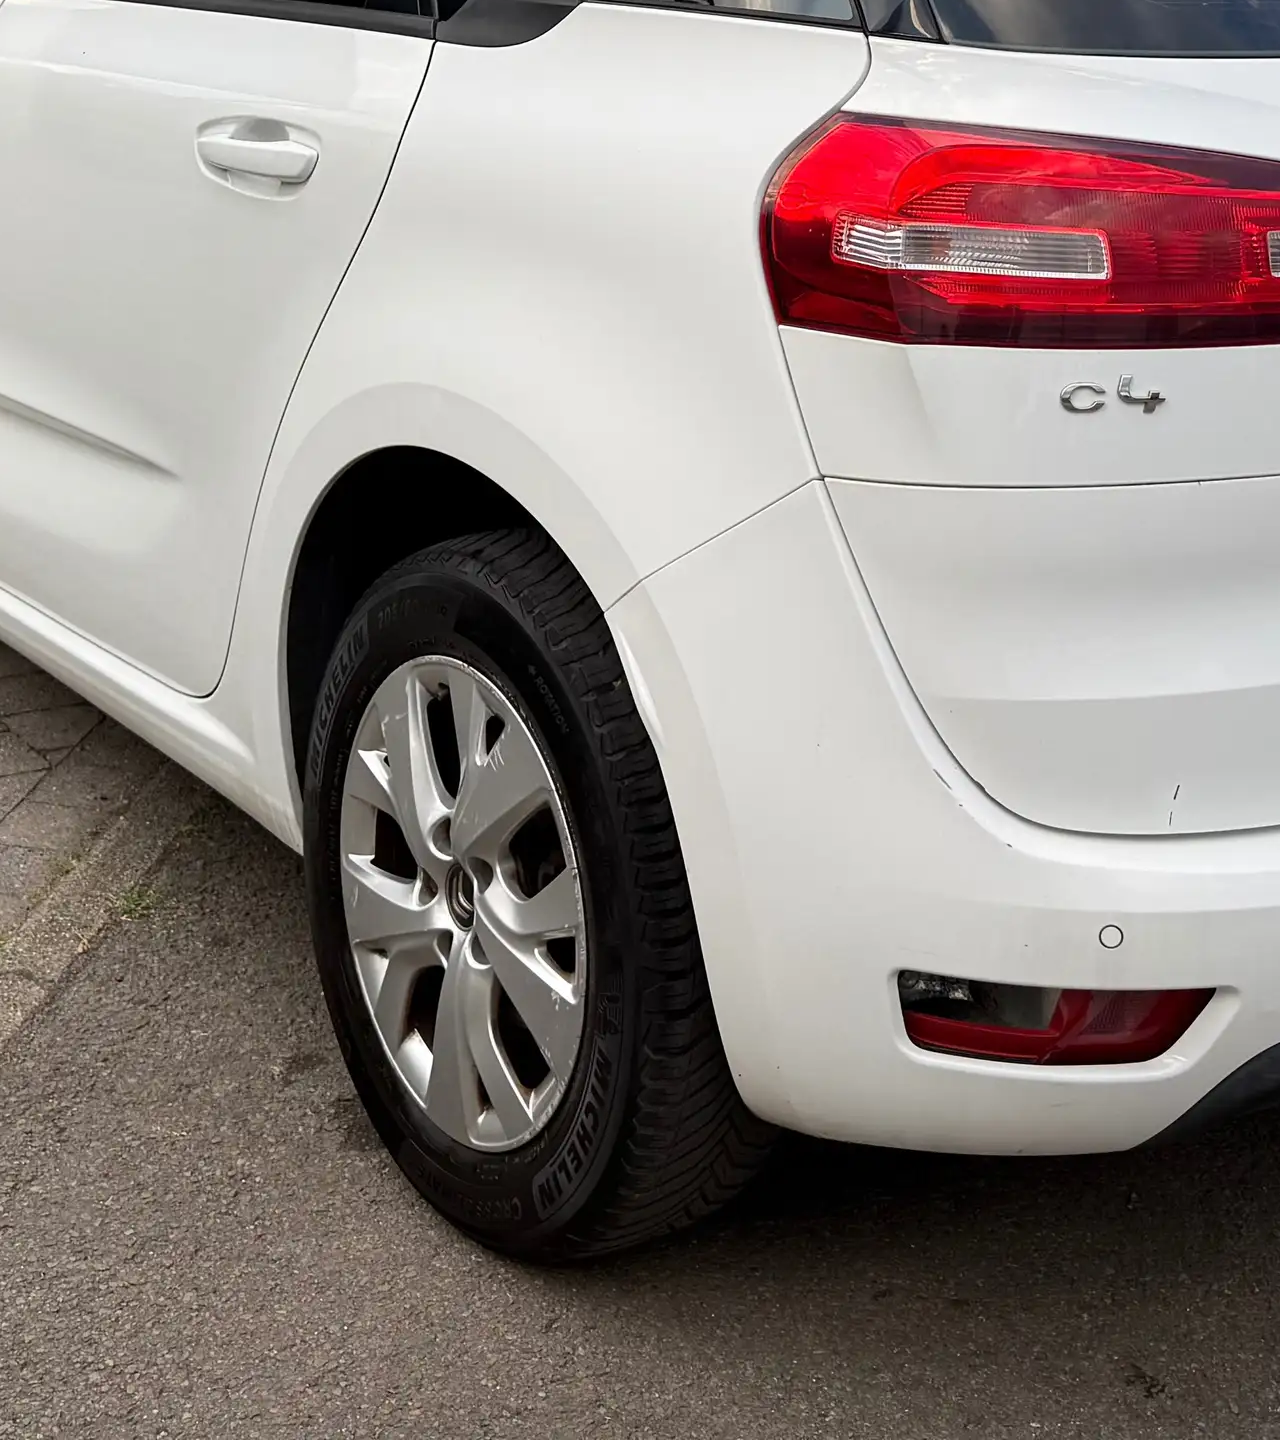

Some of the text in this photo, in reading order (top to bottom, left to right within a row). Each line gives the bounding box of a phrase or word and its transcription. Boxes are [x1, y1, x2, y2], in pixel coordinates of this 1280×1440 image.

[1059, 373, 1167, 415] C4
[310, 622, 368, 780] MICHELIN
[532, 675, 571, 735] ROTATION
[537, 1043, 613, 1212] MICHELIN
